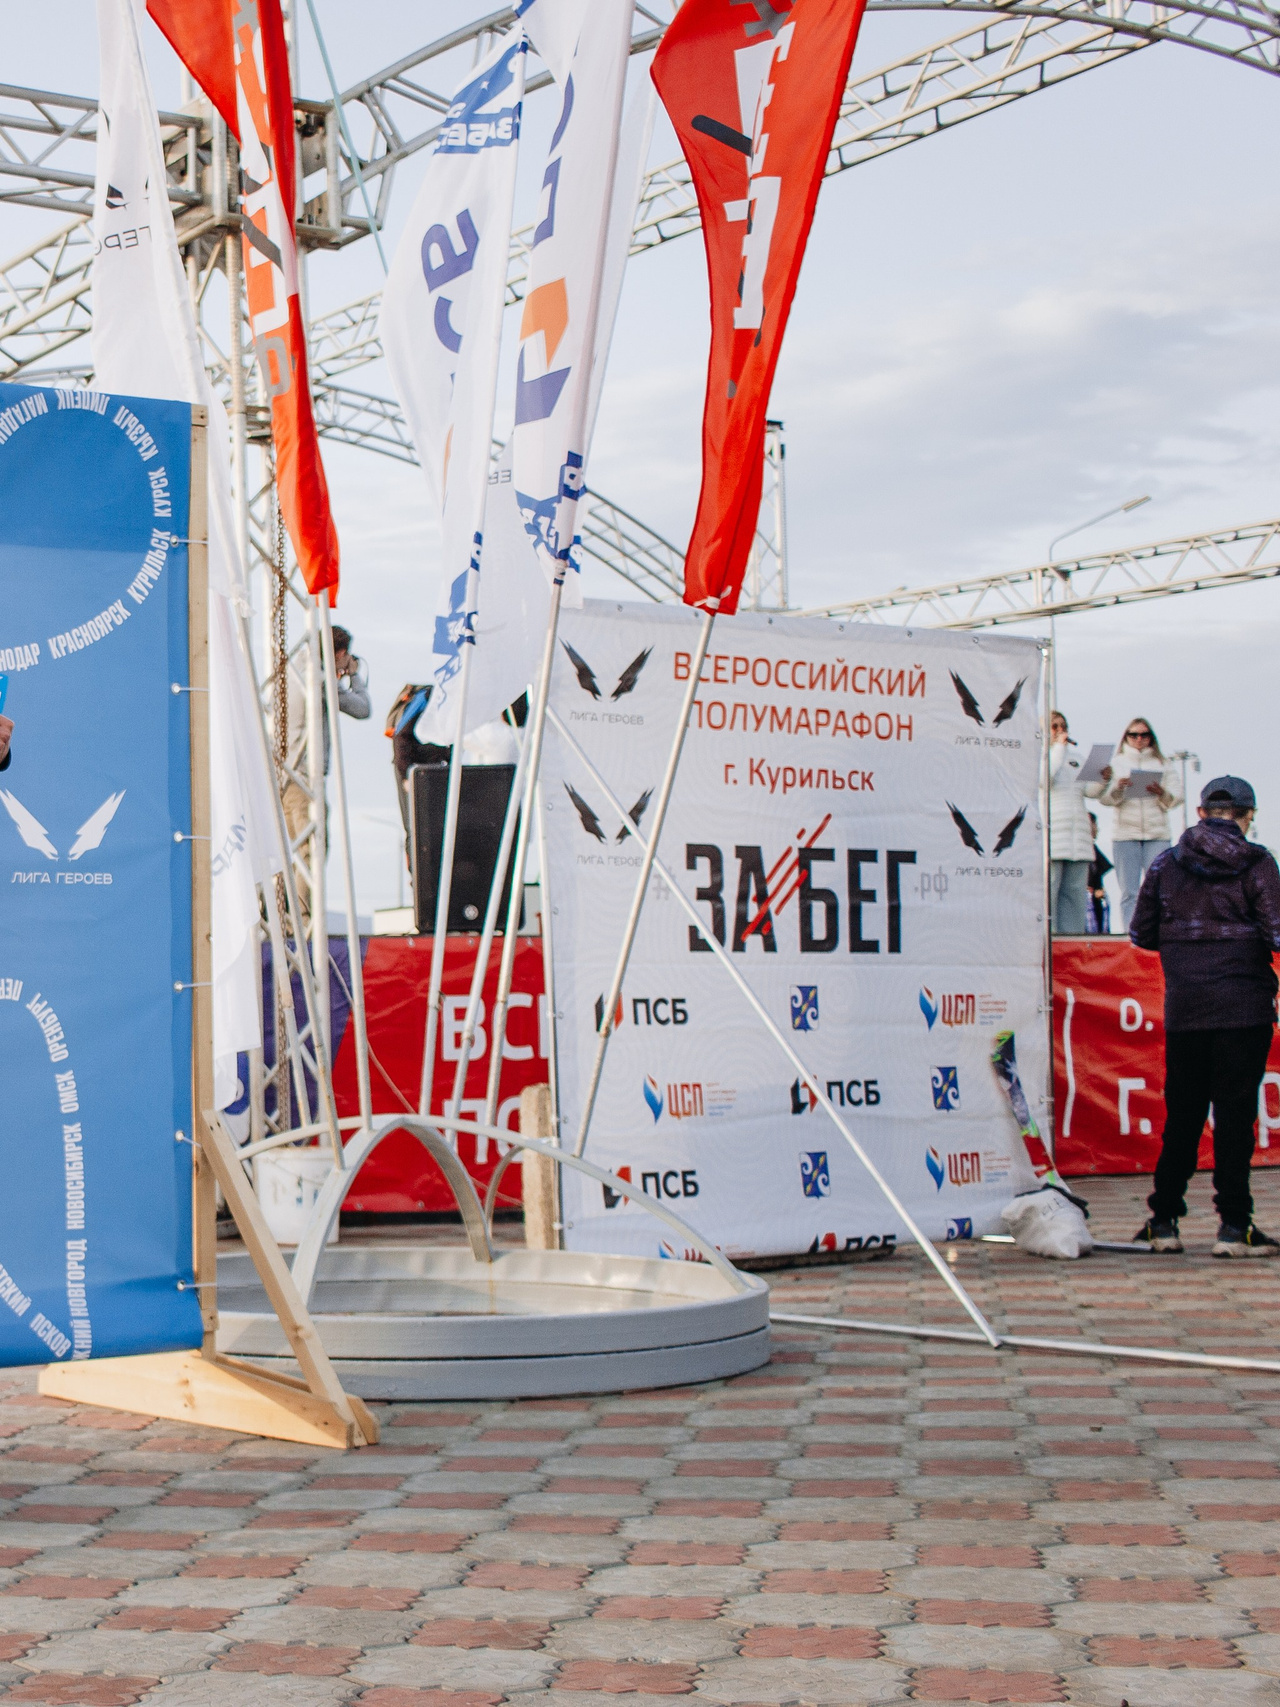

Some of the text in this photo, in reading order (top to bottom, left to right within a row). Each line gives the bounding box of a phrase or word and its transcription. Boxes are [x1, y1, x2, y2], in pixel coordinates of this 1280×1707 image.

[55, 389, 111, 415] ЛИПЕЦК
[112, 405, 159, 462] КЫЗЫЛ
[148, 466, 172, 517] КУРСК
[127, 528, 171, 605] КУРИЛЬСК
[47, 599, 131, 659] КРАСНОЯРСК
[673, 651, 926, 698] ВСЕРОССИЙСКИЙ
[570, 711, 644, 726] ЛИГА ГЕРОЕВ
[955, 735, 1021, 749] ЛИГА ГЕРОЕВ
[723, 757, 875, 794] г. Курильск
[11, 872, 113, 885] ЛИГА ГЕРОЕВ
[576, 854, 644, 867] ЛИГА ГЕРОЕ
[955, 866, 1024, 878] ЛИГА ГЕРОЕВ
[26, 992, 69, 1062] ОРЕНБУРГ
[632, 998, 689, 1026] ПСБ
[941, 994, 975, 1029] ЦСП
[55, 1070, 79, 1114] ОМСК
[667, 1082, 704, 1120] ЦСП
[826, 1079, 881, 1107] ПСБ
[63, 1122, 85, 1229] НОВОСИБИРСК
[641, 1170, 699, 1199] ПСБ
[947, 1152, 982, 1187] ЦСП
[66, 1238, 89, 1318] НОВГОРОД
[29, 1313, 72, 1359] ПСКОВ
